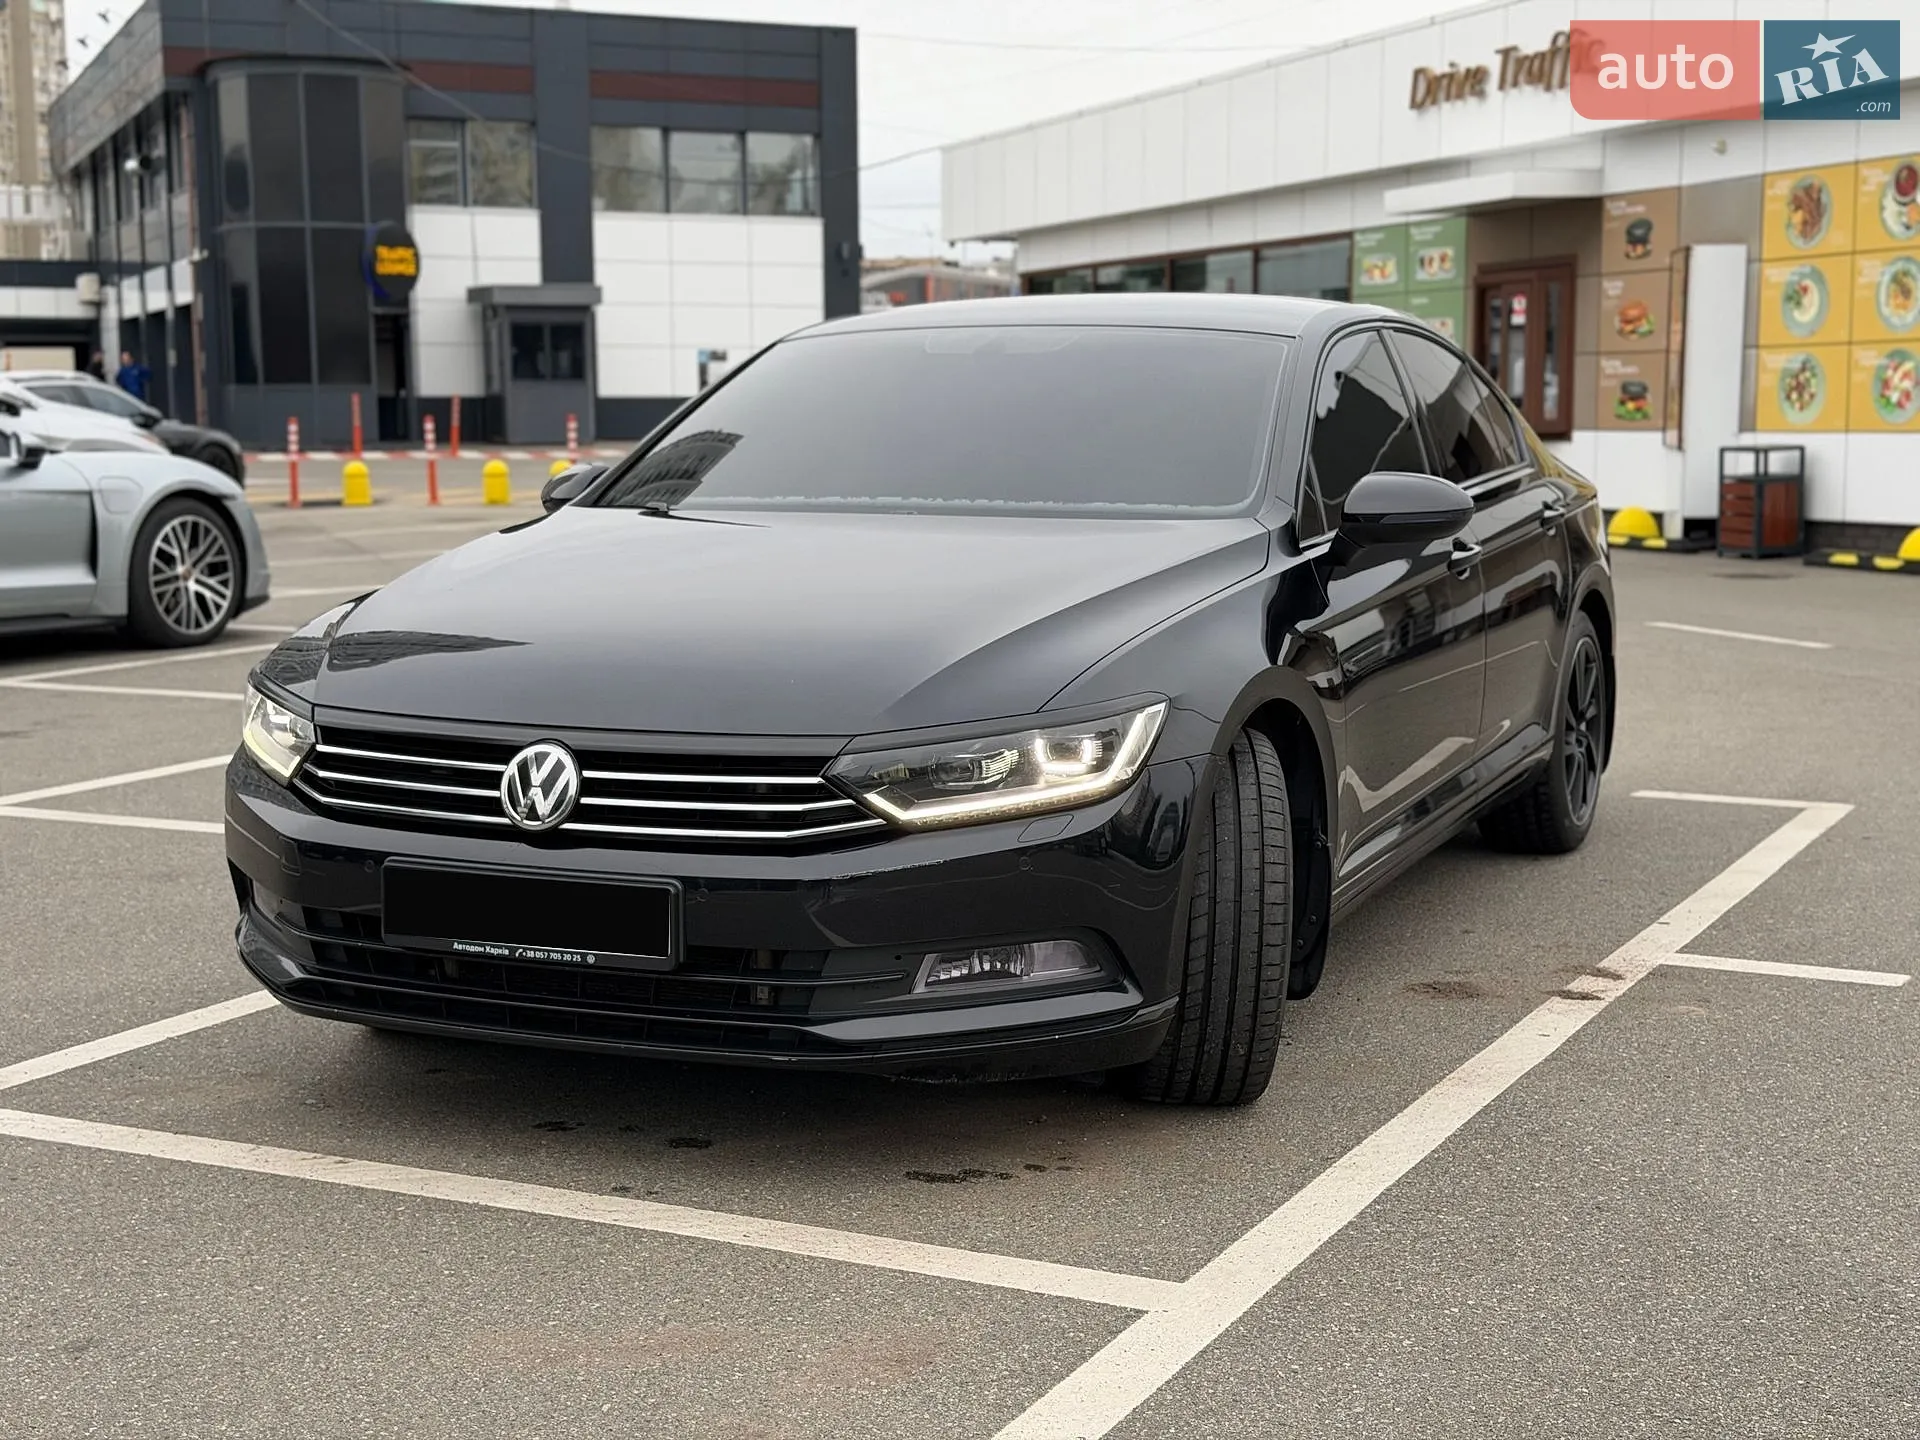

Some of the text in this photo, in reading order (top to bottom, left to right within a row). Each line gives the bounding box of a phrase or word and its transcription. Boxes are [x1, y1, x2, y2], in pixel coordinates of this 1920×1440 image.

[1409, 61, 1490, 110] Drive
[504, 747, 575, 824] VW
[452, 941, 485, 953] Автодом
[485, 945, 510, 956] Харків
[522, 950, 535, 958] +38
[535, 951, 549, 959] 057
[549, 952, 562, 960] 705
[572, 954, 582, 962] 25
